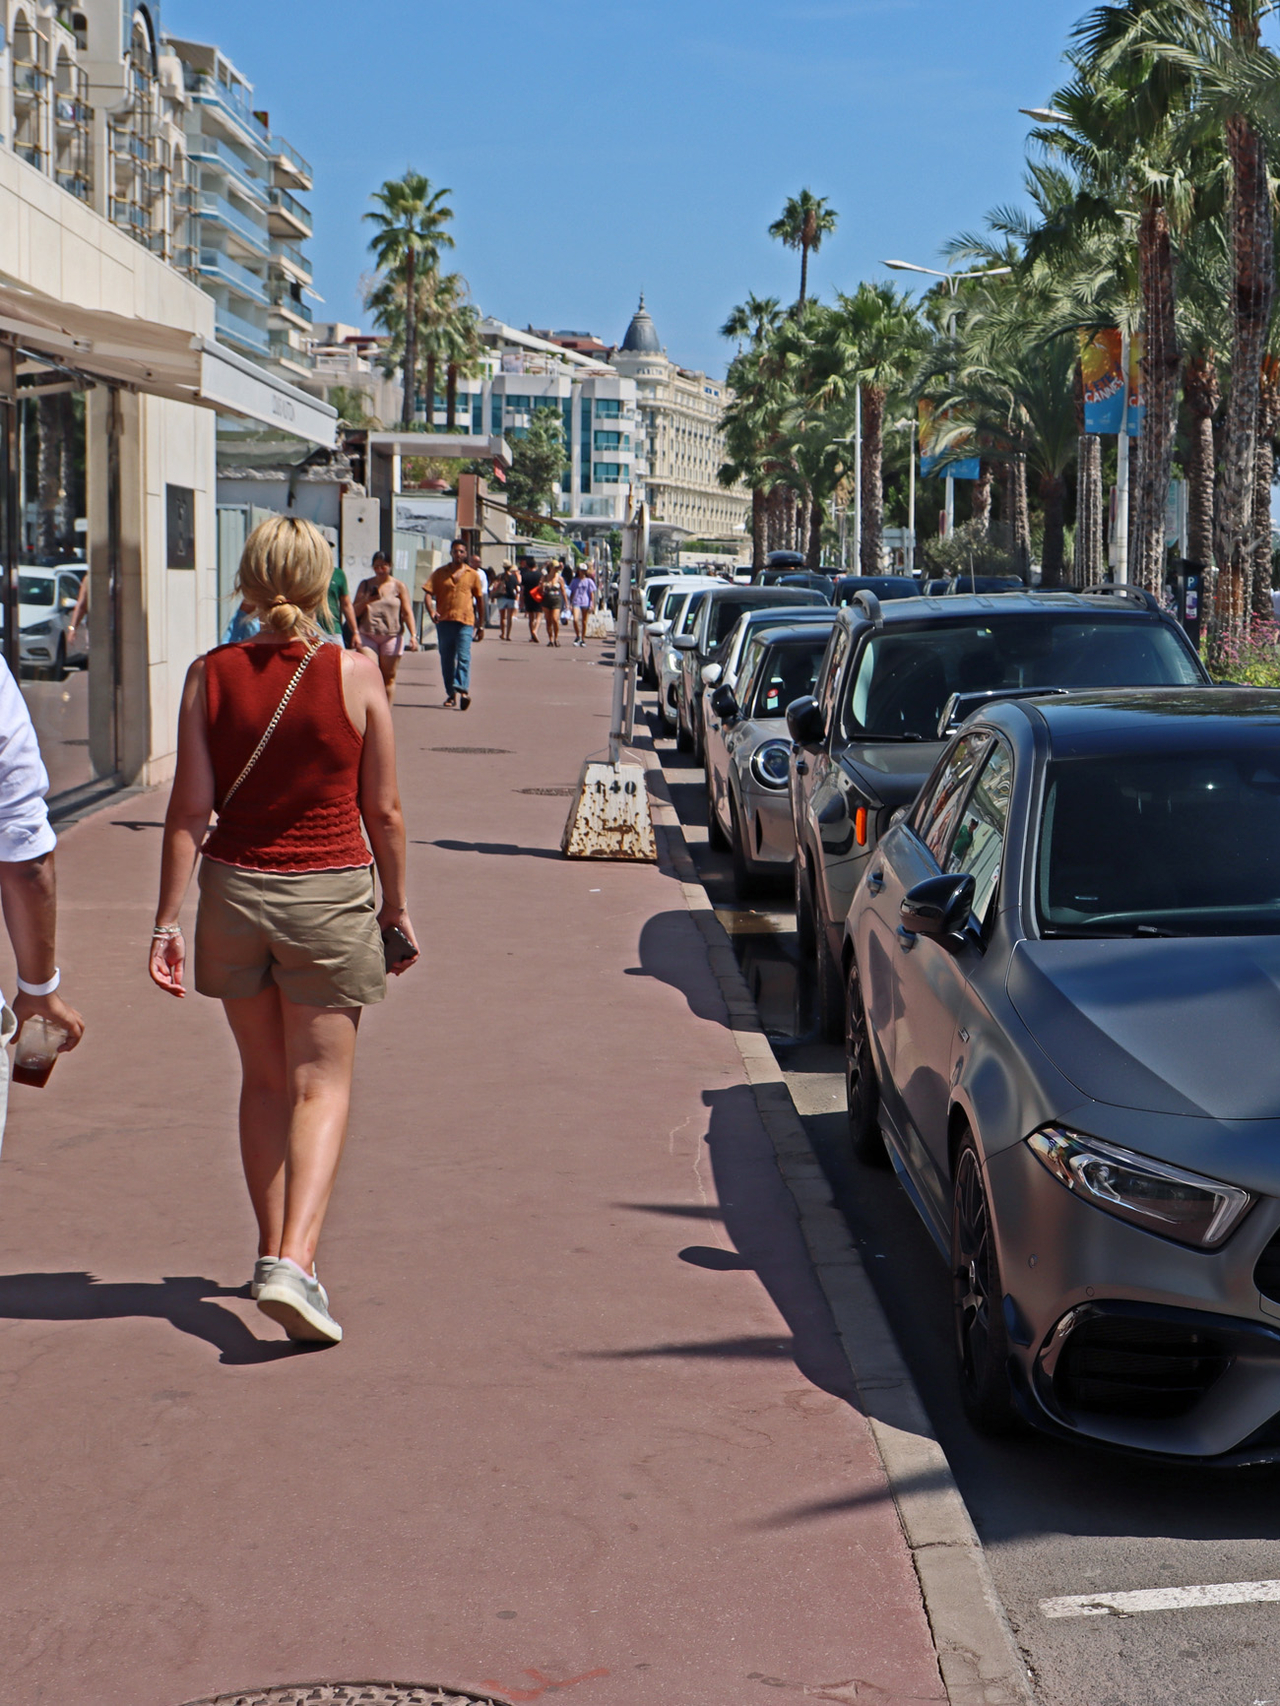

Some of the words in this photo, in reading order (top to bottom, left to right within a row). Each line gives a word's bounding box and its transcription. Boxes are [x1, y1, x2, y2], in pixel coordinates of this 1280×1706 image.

[1084, 376, 1125, 403] CANNES
[1187, 576, 1195, 587] P
[595, 780, 637, 795] 140
